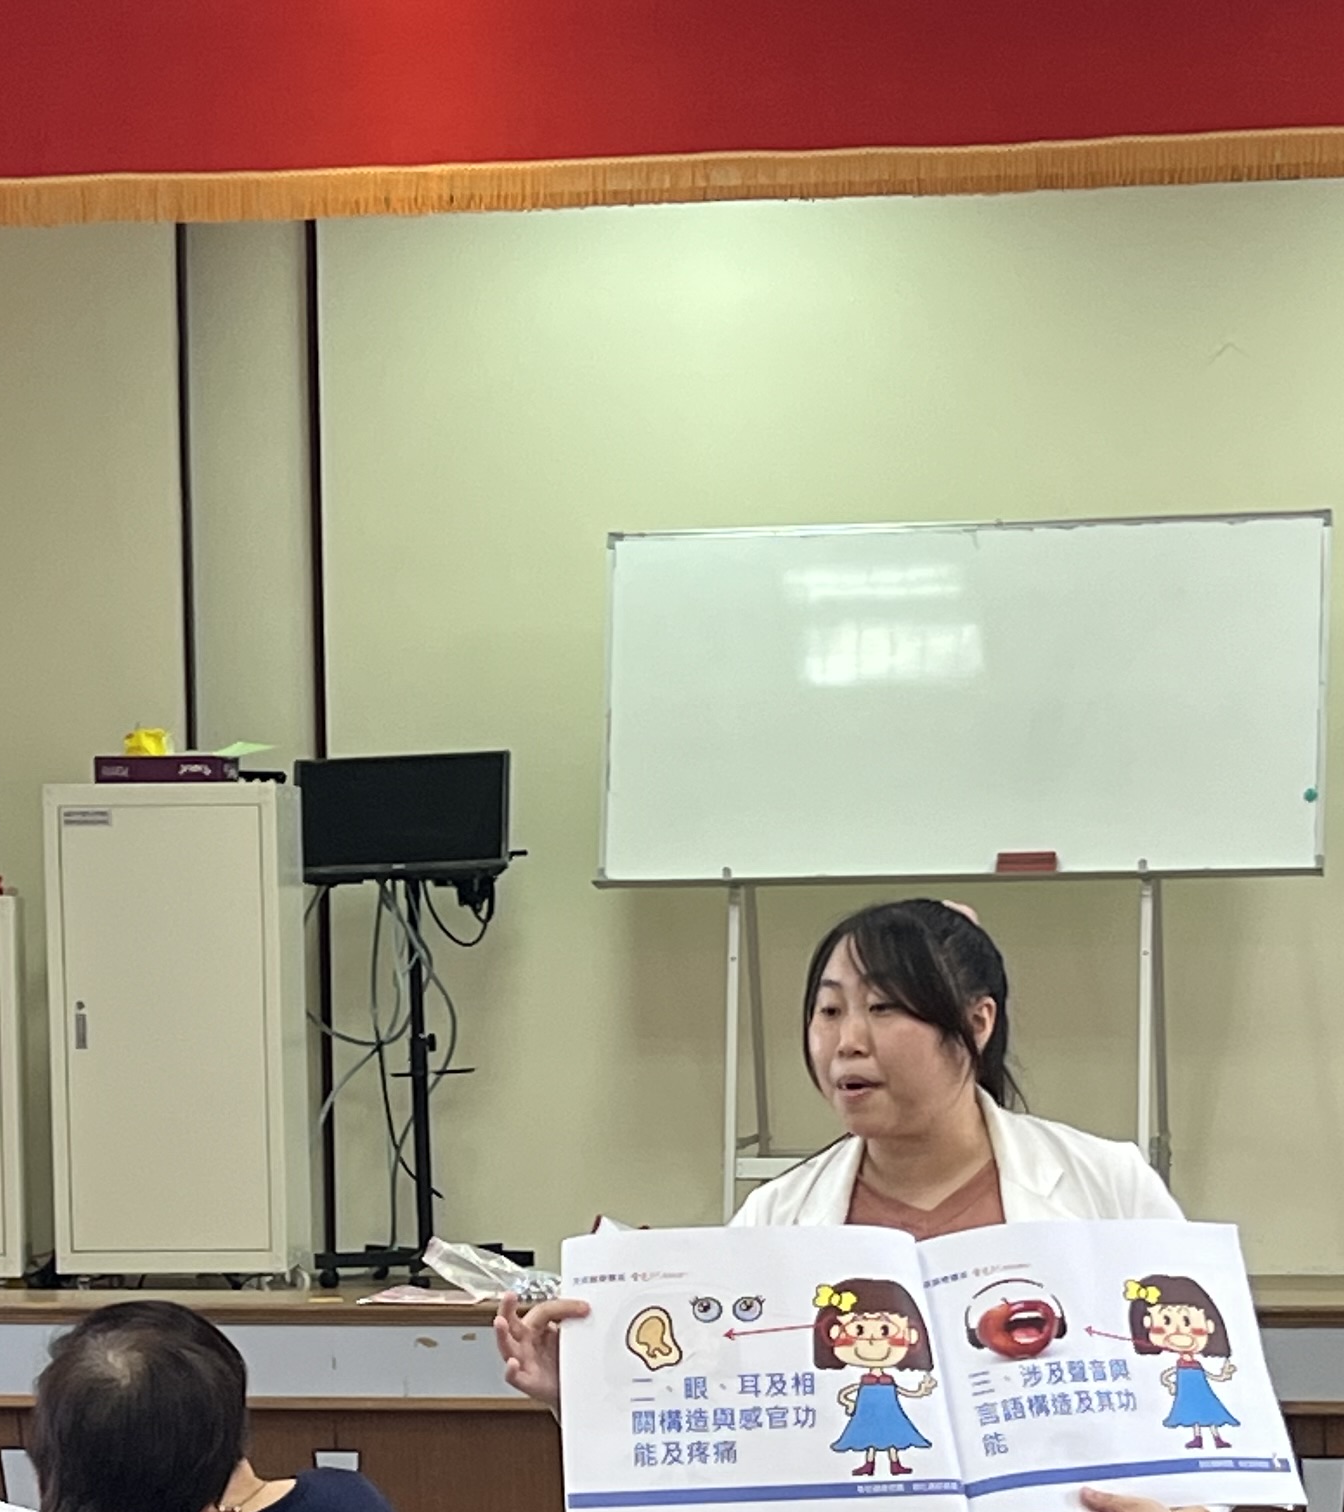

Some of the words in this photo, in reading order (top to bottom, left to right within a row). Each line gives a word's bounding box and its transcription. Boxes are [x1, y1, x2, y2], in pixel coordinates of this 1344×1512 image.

[630, 1371, 816, 1402] 二、眼、耳及相
[631, 1405, 817, 1434] 關構造與感官功
[633, 1440, 738, 1467] 能及疼痛
[982, 1431, 1009, 1457] 能
